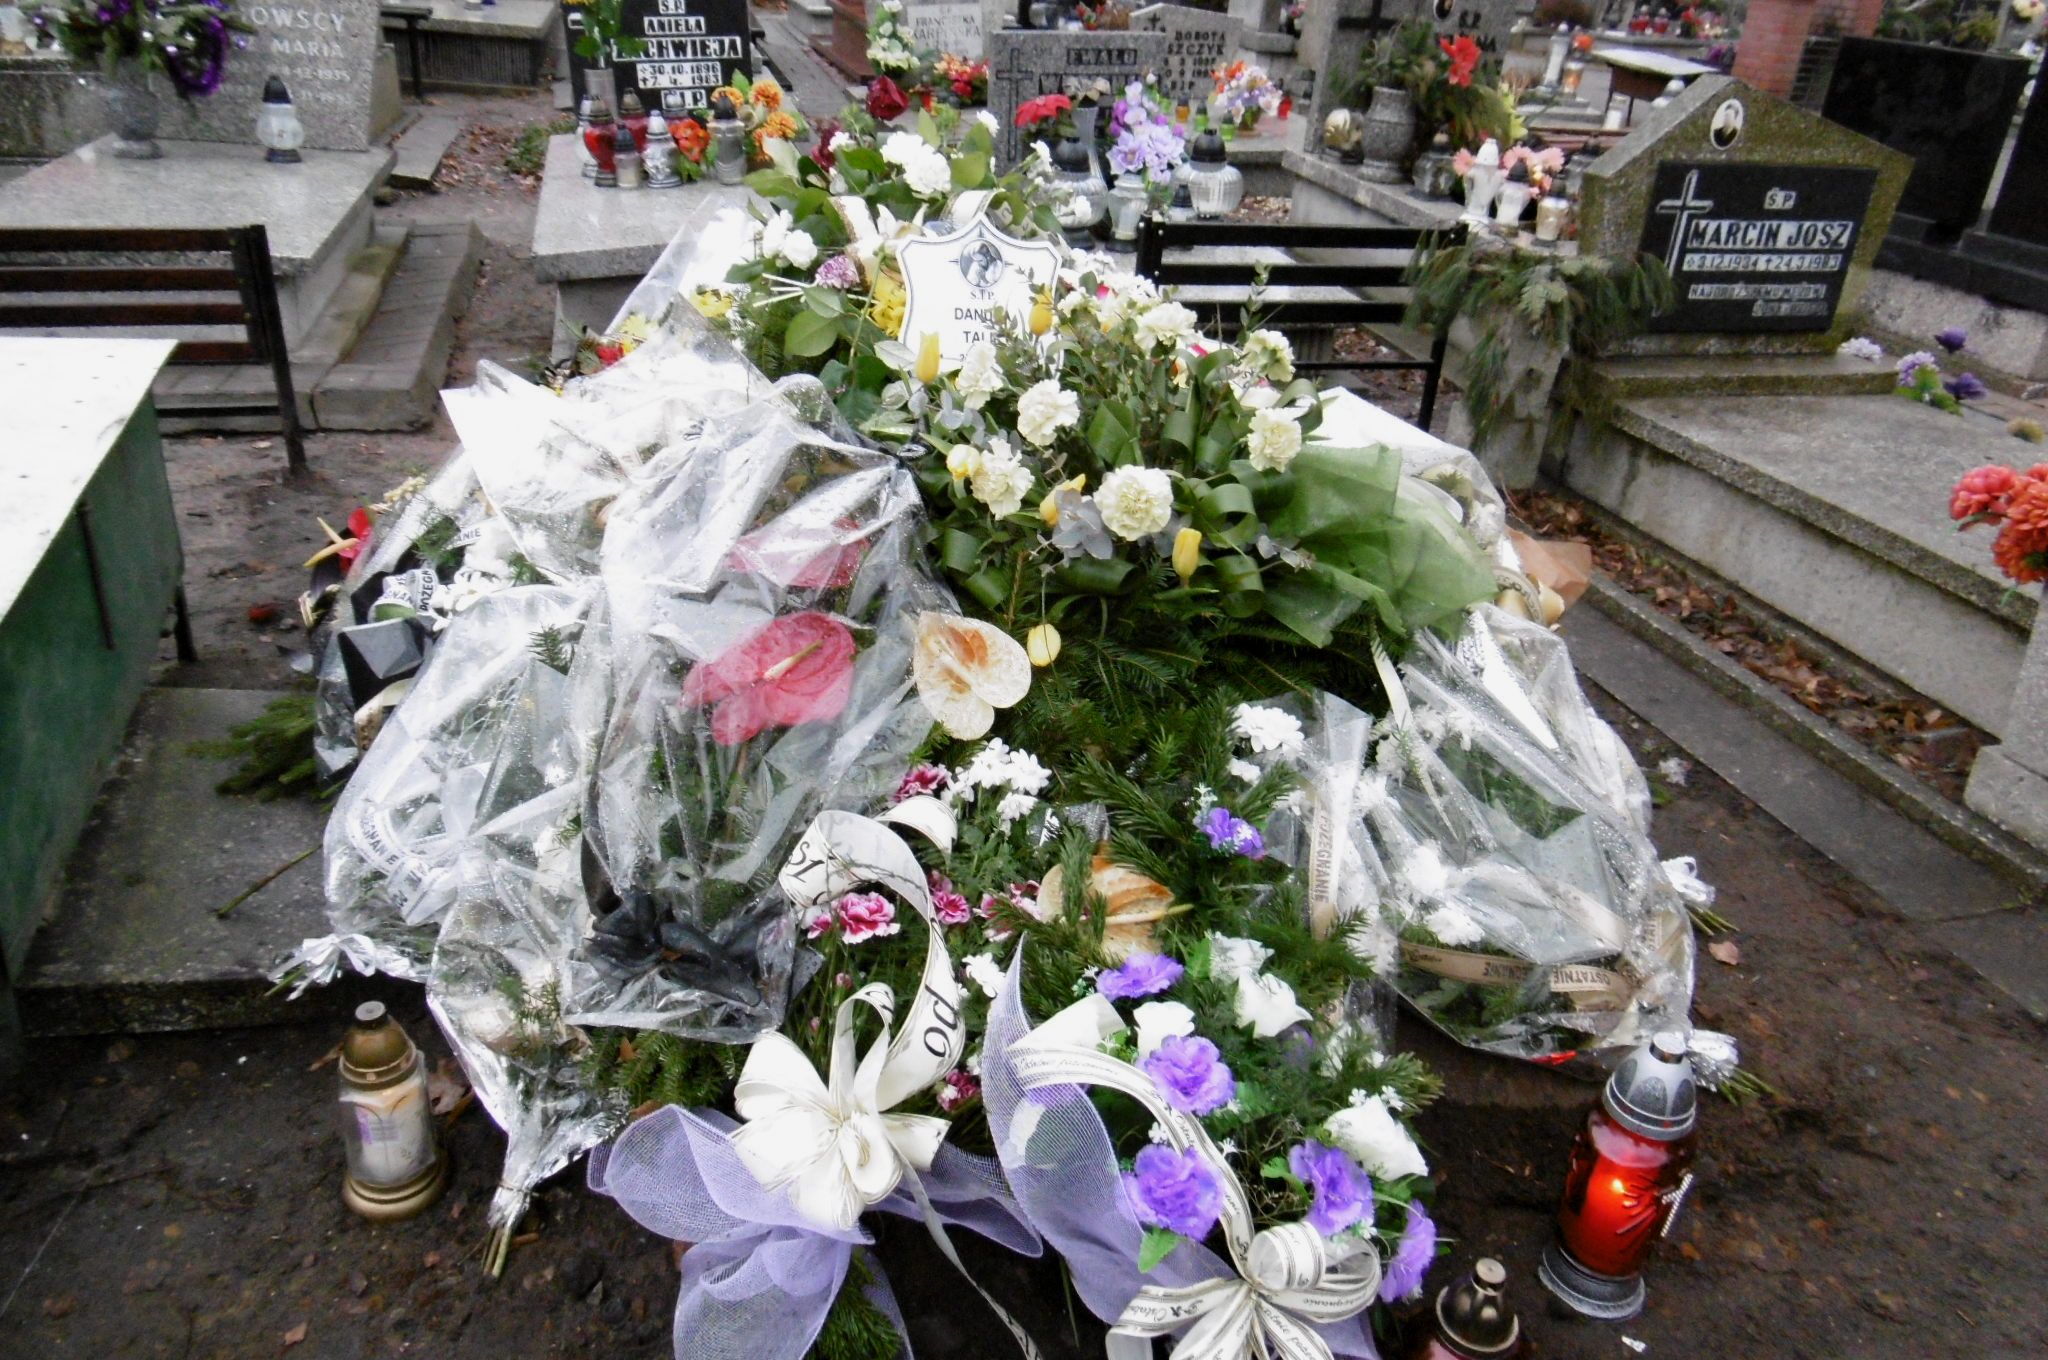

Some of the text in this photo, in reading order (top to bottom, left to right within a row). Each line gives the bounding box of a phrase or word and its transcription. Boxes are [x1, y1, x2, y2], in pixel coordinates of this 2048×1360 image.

[645, 17, 705, 32] ANIELA
[615, 37, 741, 60] CHWIEJA
[1690, 222, 1850, 248] MARCIN JOSZ
[954, 308, 1011, 321] DANUA
[1553, 967, 1611, 986] OSTATNIE
